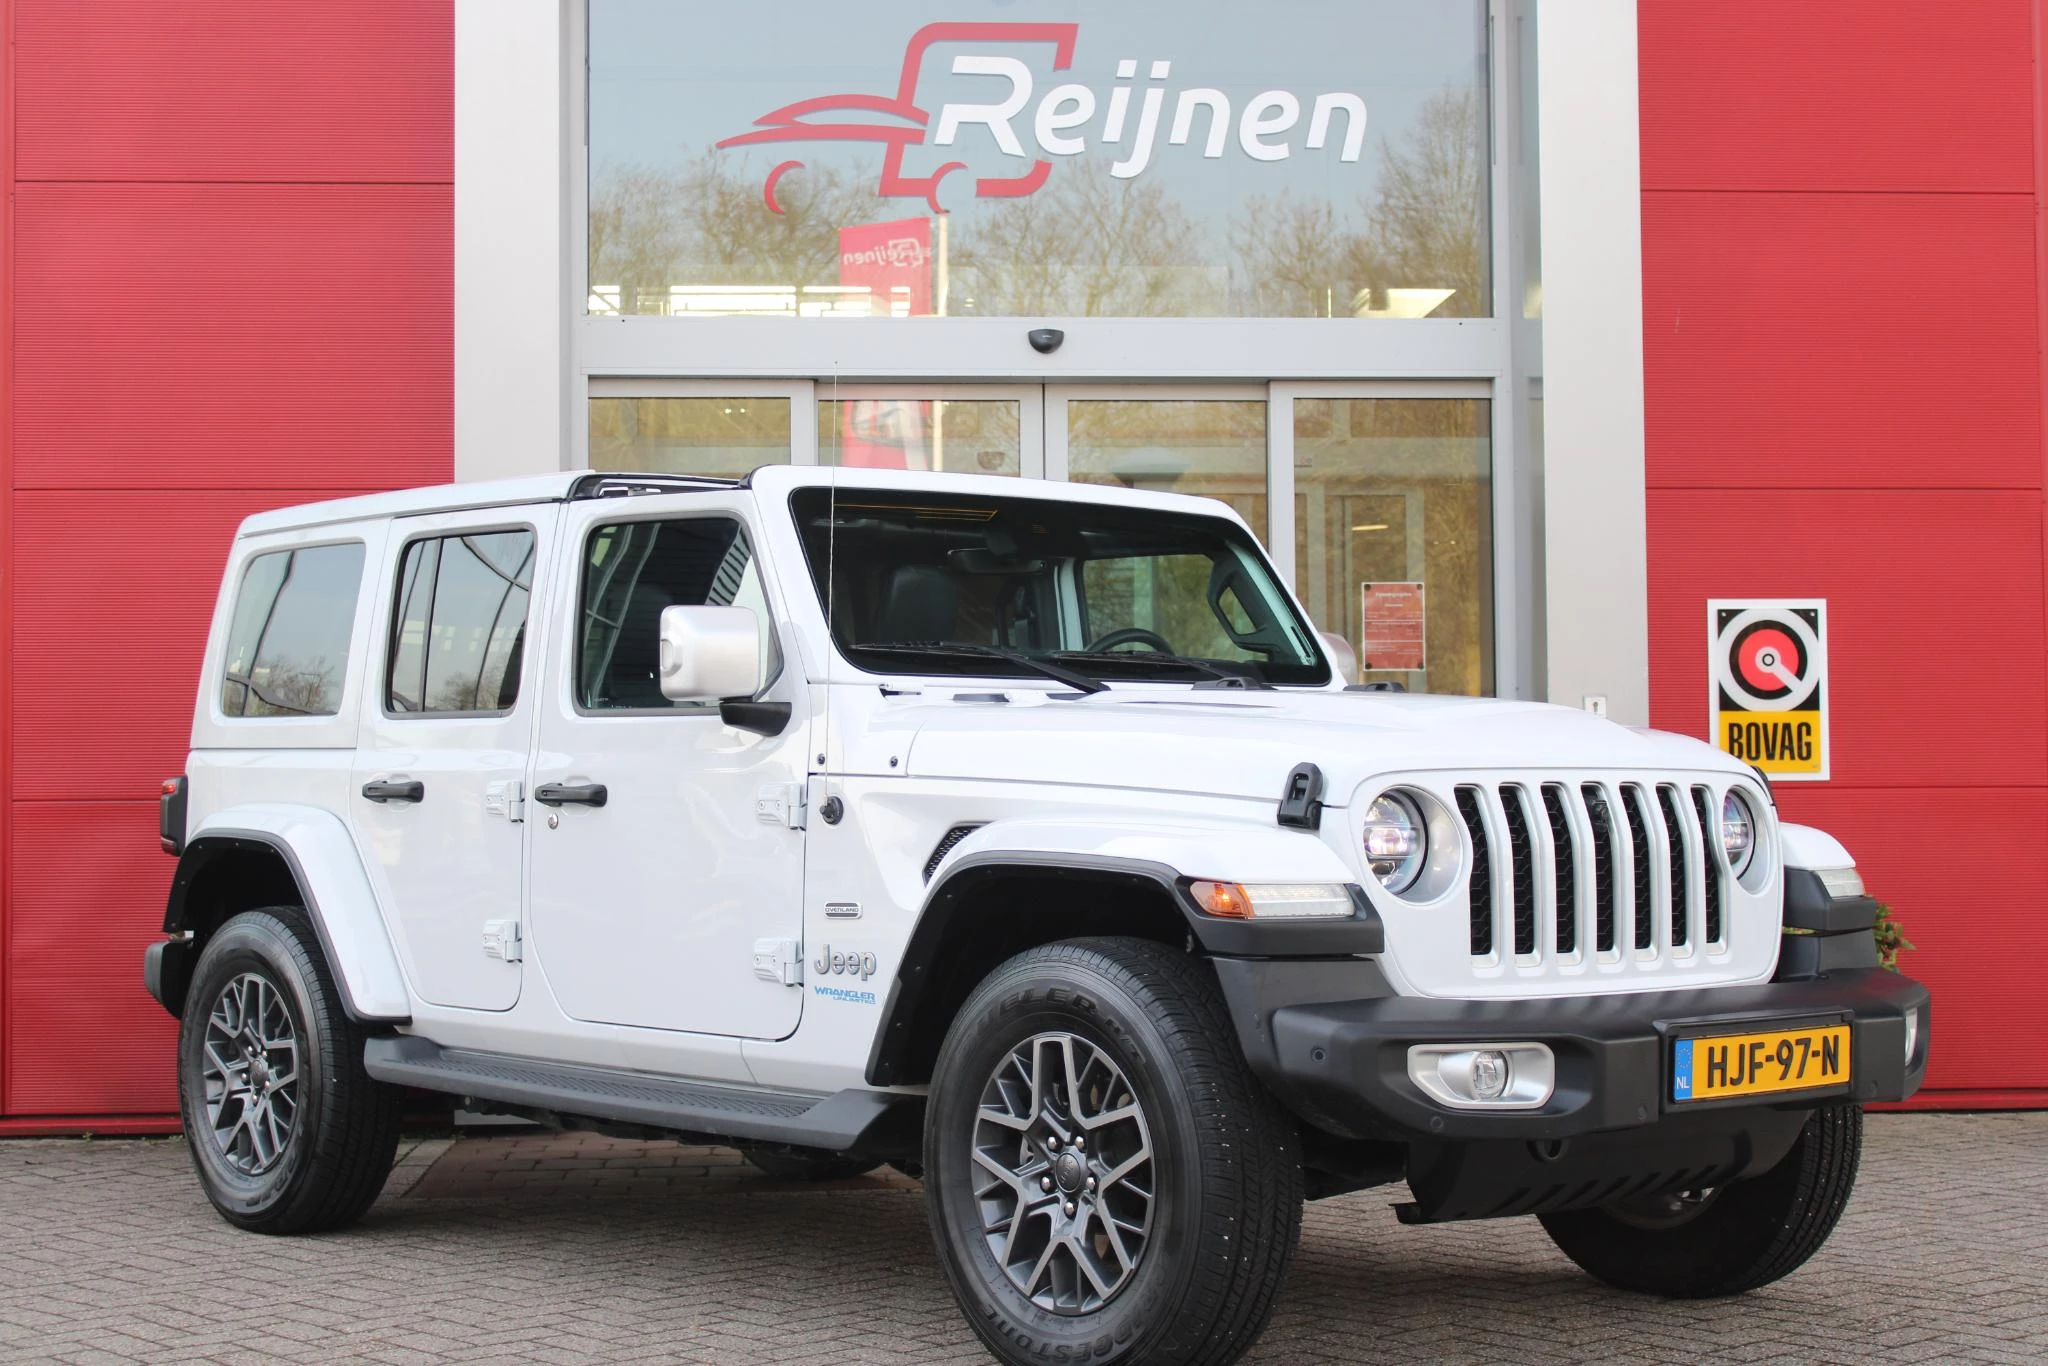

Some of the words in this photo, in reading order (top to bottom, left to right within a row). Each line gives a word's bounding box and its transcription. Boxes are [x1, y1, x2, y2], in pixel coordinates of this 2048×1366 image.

[934, 55, 1367, 178] Reijnen
[1728, 721, 1812, 761] BOVAG
[814, 944, 877, 981] Jeep
[814, 985, 875, 1000] WRANGLER
[1707, 1034, 1840, 1088] HJF-97-N
[1676, 1076, 1690, 1089] NL
